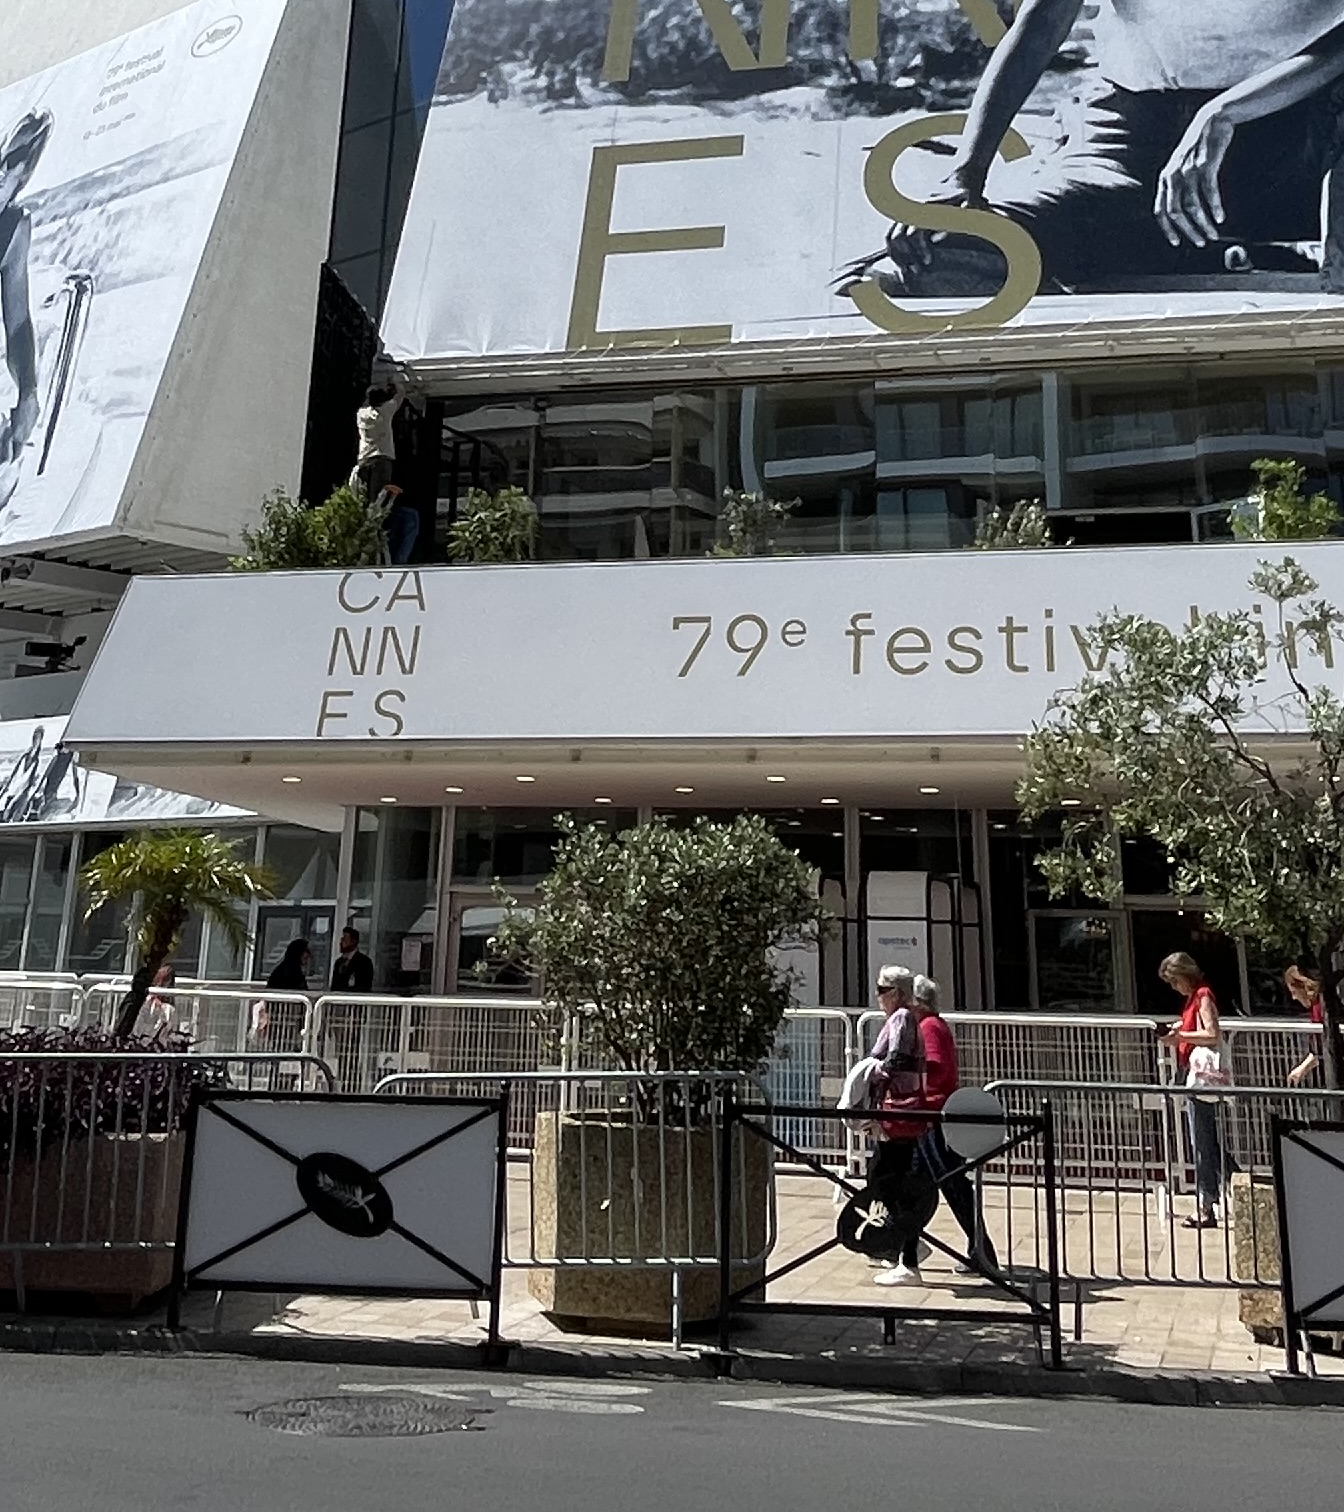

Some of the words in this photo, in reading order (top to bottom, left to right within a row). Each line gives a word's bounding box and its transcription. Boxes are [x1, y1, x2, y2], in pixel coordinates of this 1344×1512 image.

[566, 112, 1043, 350] ES
[338, 571, 426, 613] CA
[327, 625, 421, 676] NN
[672, 614, 807, 679] 79e
